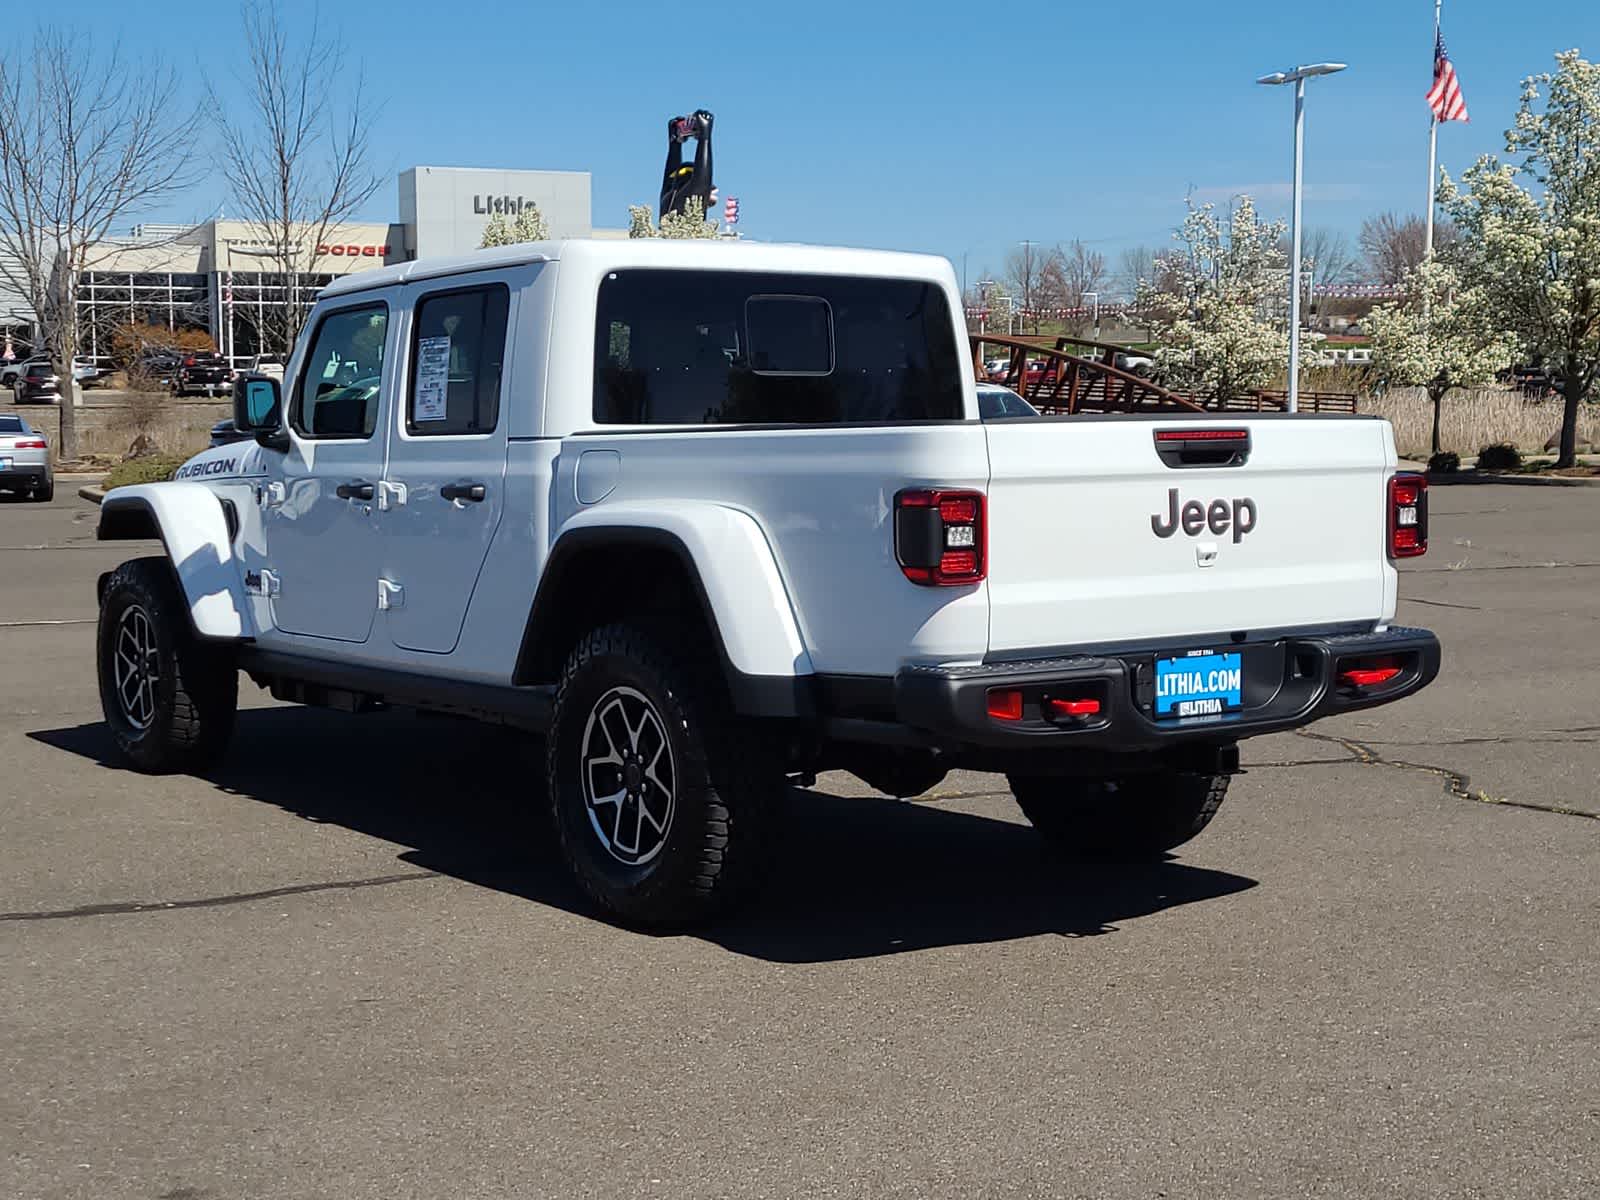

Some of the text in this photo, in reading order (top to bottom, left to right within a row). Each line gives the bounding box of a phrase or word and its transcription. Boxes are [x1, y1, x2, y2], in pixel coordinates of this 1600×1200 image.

[315, 245, 391, 256] DODGE
[176, 458, 236, 480] RUBICON
[1151, 487, 1257, 544] Jeep
[1157, 669, 1240, 696] LITHIA.COM
[1190, 699, 1222, 715] LITHIA
